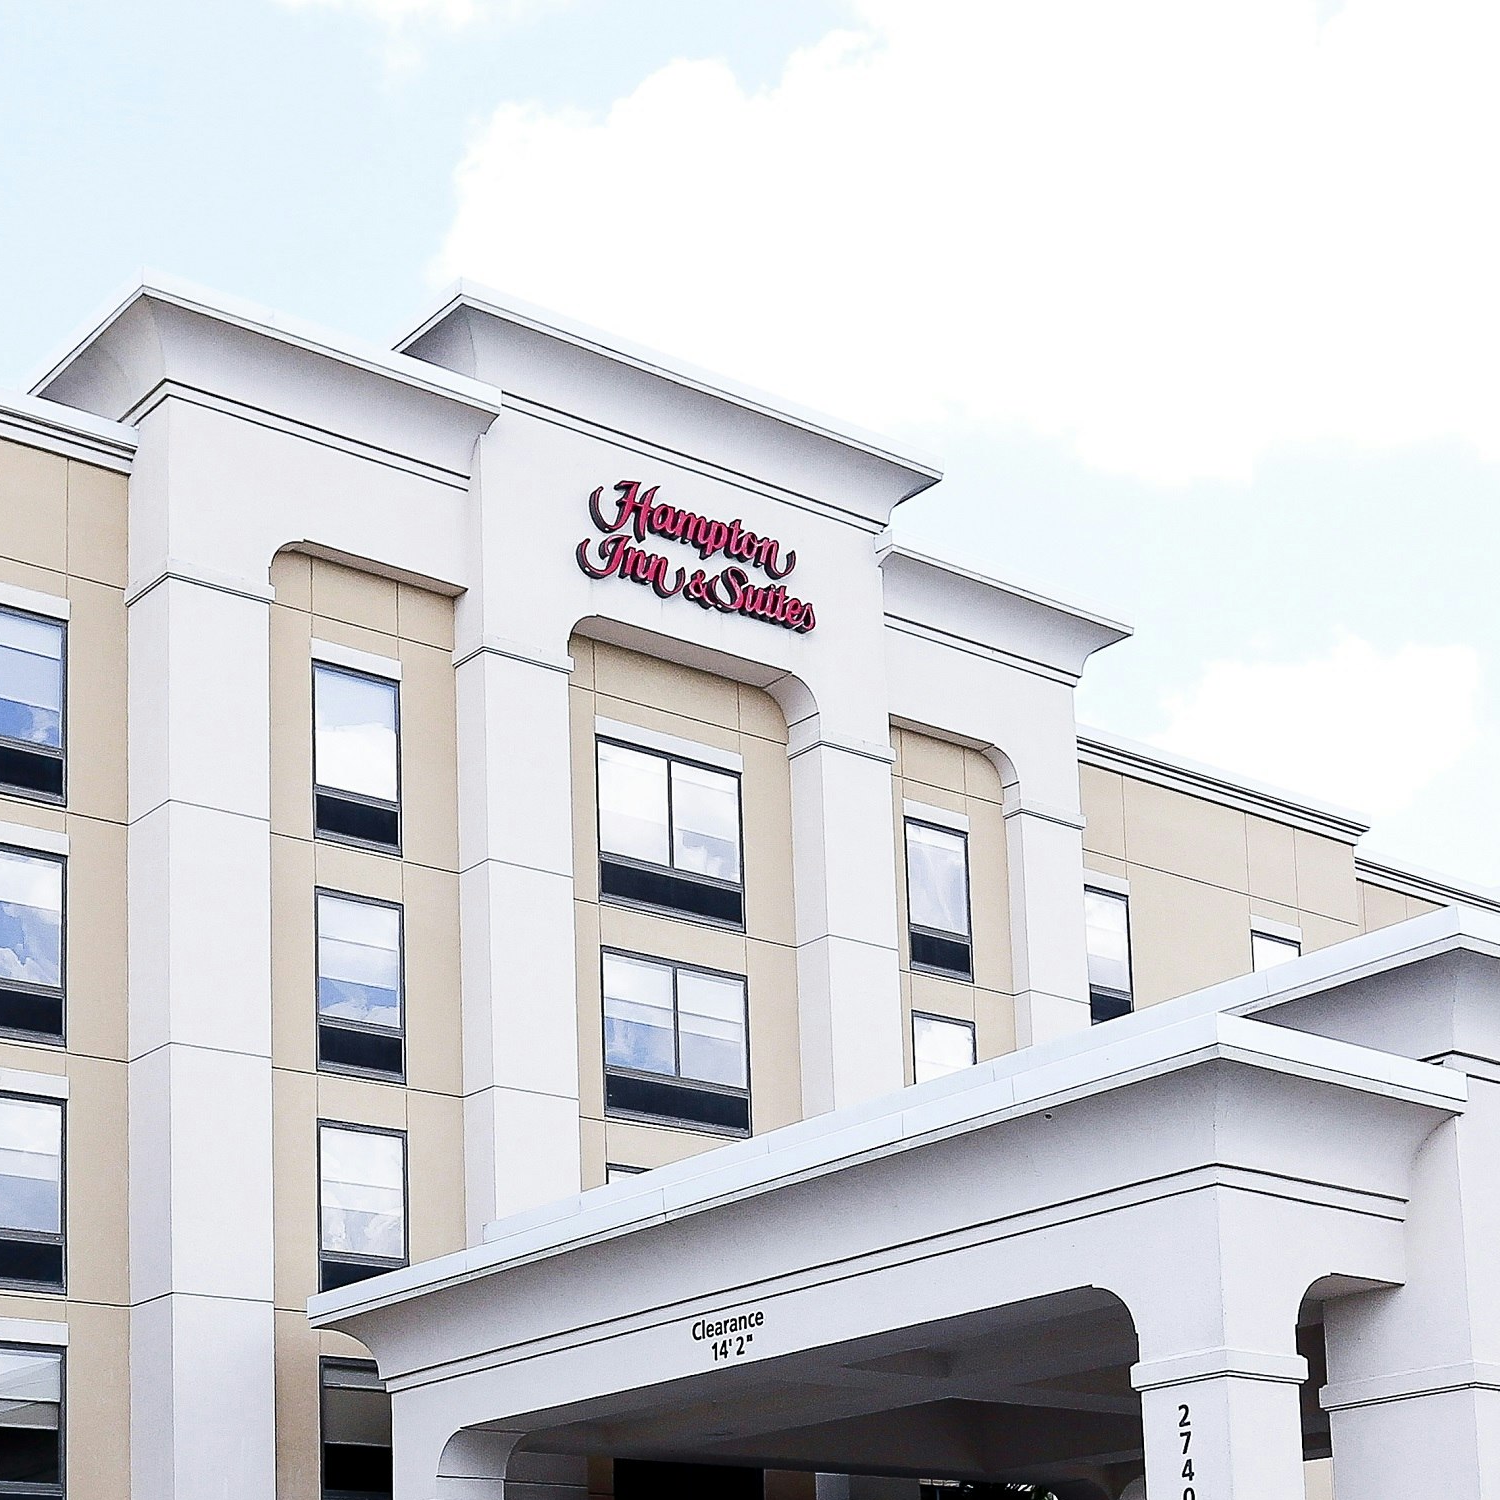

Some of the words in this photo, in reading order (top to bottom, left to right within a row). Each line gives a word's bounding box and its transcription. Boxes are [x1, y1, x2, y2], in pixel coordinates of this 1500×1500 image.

[589, 480, 796, 580] Hampton
[576, 534, 686, 600] Inn
[683, 568, 716, 610] &
[707, 566, 816, 634] Suites
[692, 1311, 764, 1341] Clearance
